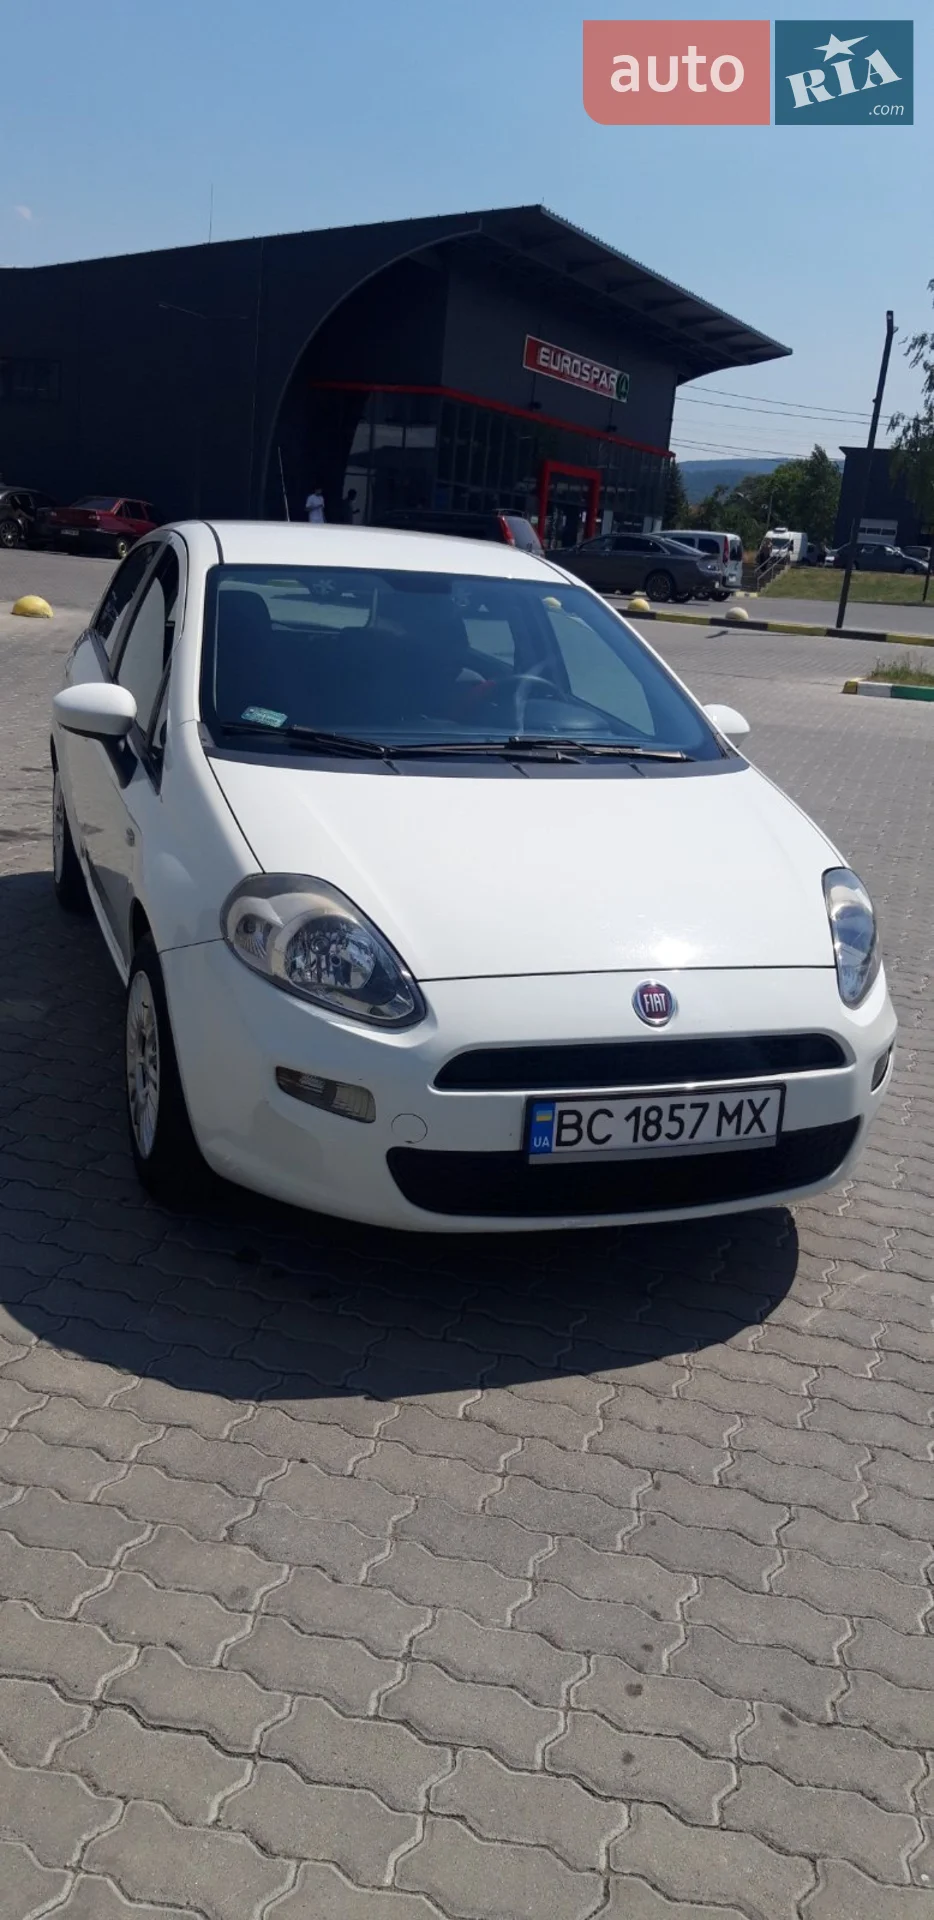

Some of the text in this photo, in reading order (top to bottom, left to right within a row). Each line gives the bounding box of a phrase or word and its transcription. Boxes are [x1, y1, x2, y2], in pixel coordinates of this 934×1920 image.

[537, 346, 618, 390] EUROSPAR
[643, 993, 666, 1013] FIAT
[555, 1096, 771, 1147] BC 1857 MX
[533, 1136, 550, 1149] UA
